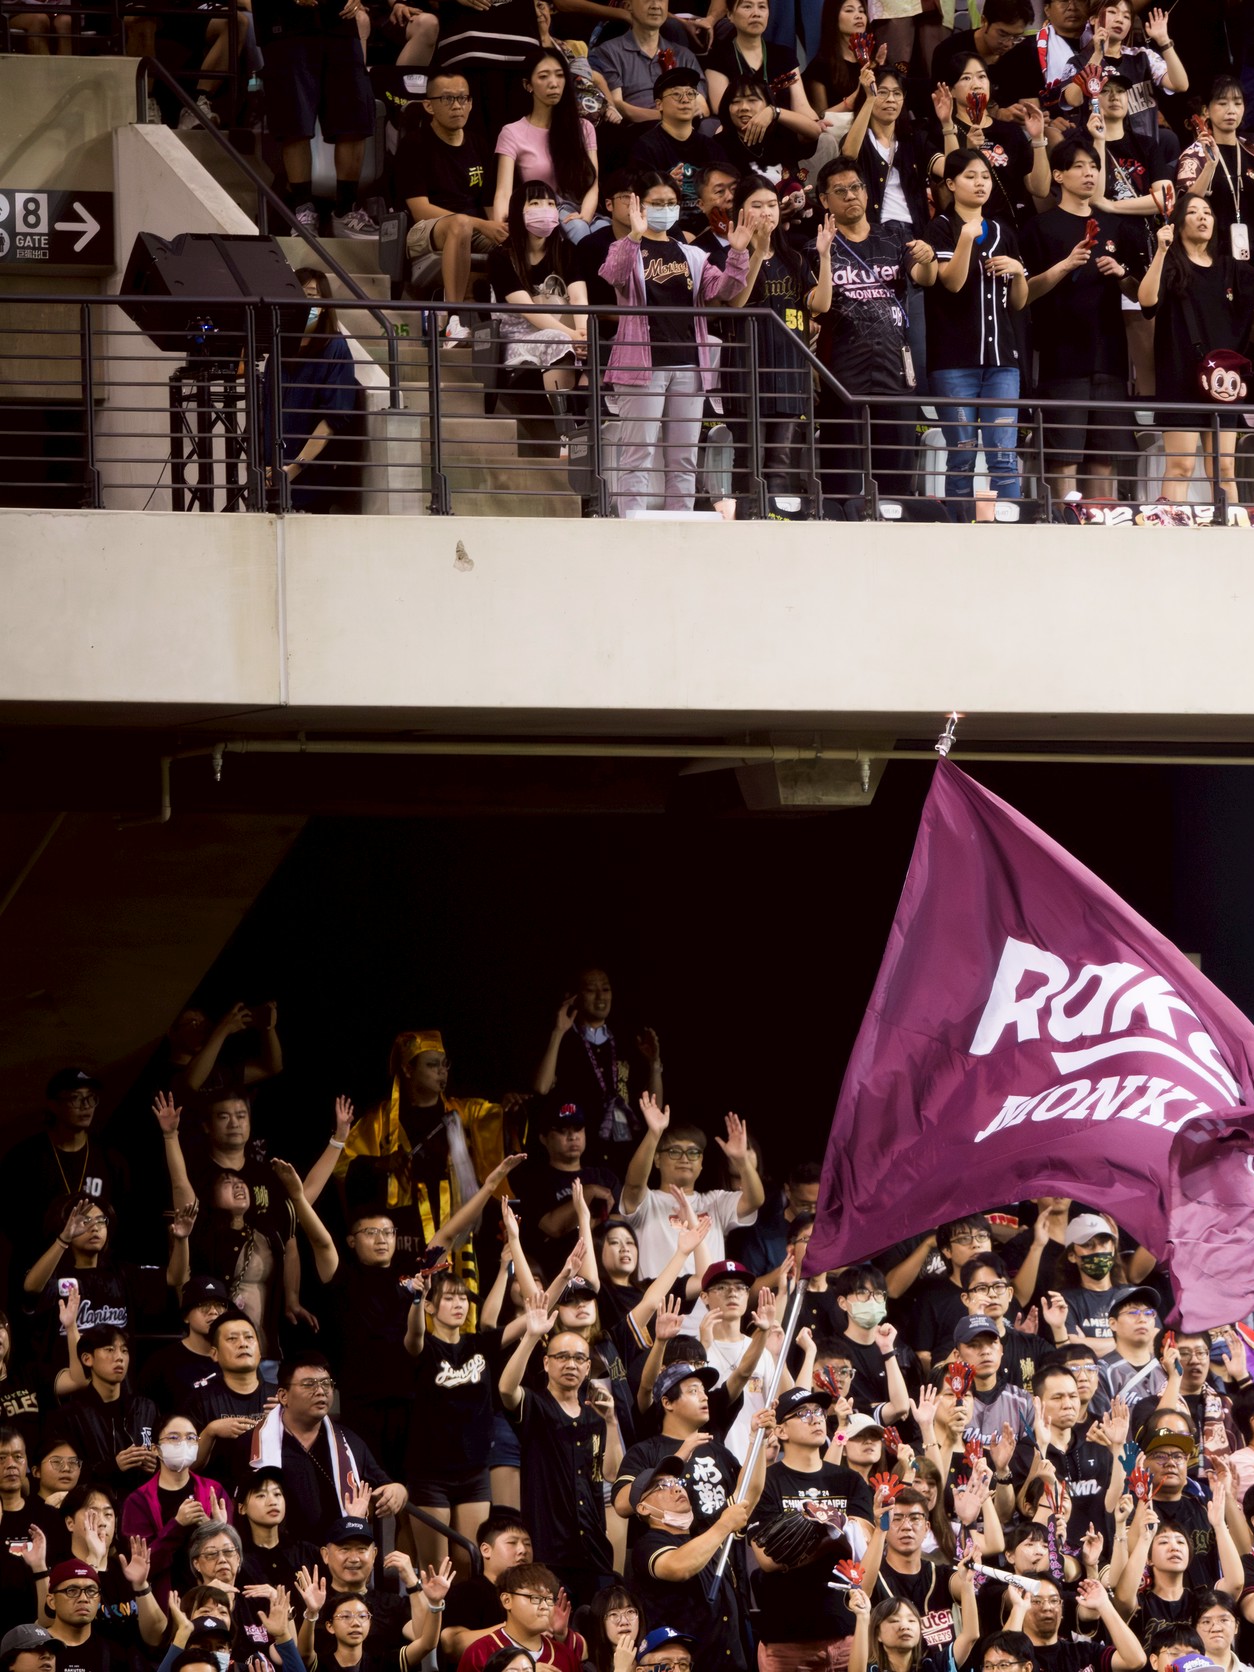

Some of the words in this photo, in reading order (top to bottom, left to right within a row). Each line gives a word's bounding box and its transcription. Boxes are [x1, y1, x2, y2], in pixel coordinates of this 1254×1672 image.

[468, 165, 484, 188] 武
[22, 197, 42, 230] 8
[16, 236, 49, 248] GATE
[16, 250, 49, 260] 巨蛋出口
[726, 1261, 736, 1271] R
